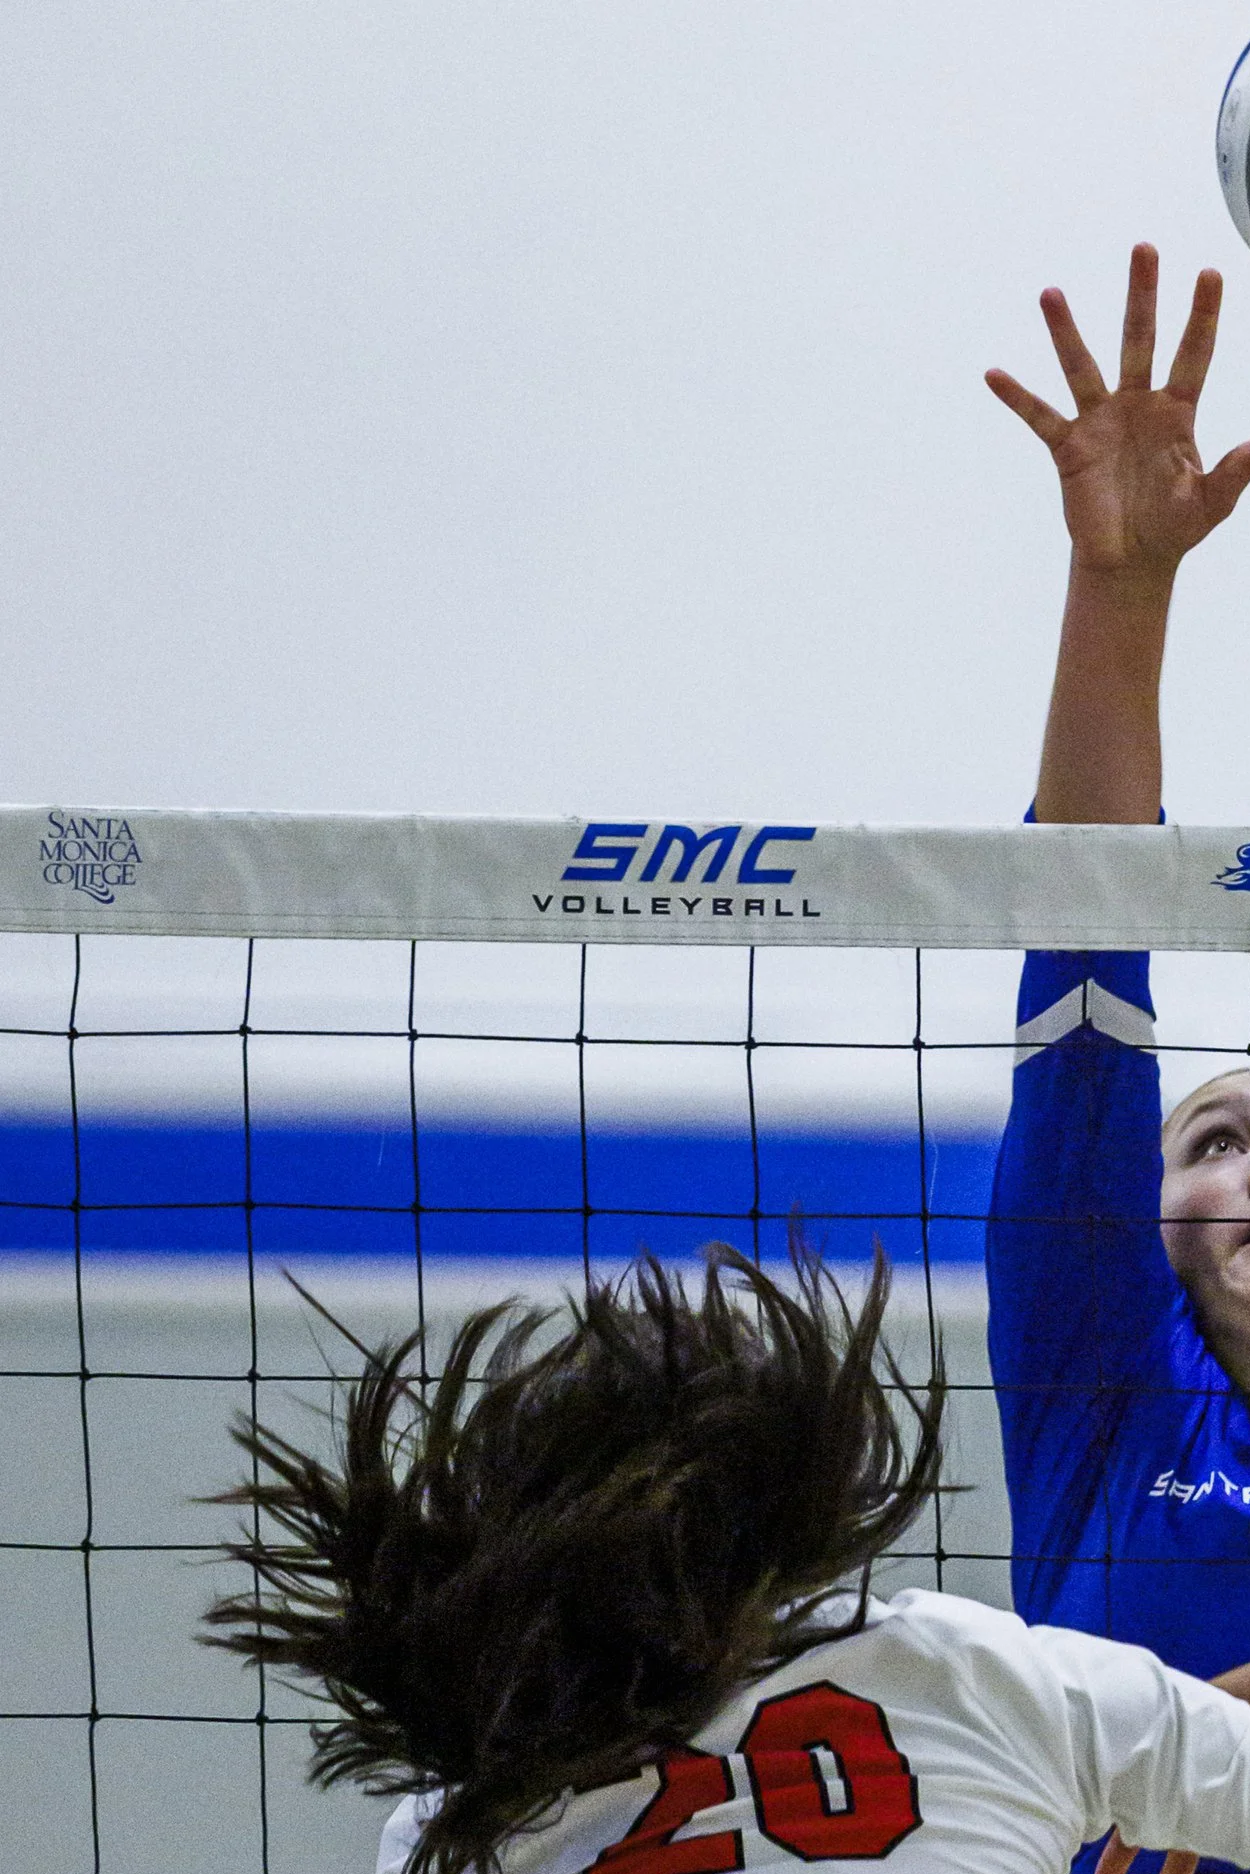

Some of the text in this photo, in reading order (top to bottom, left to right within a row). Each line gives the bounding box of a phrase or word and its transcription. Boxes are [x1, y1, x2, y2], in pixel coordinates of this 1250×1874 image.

[48, 811, 134, 840] SANTA
[39, 840, 142, 863] MONICA
[560, 823, 817, 884] SMC
[43, 863, 136, 904] COLLEGE
[532, 894, 821, 917] VOLLEYBALL
